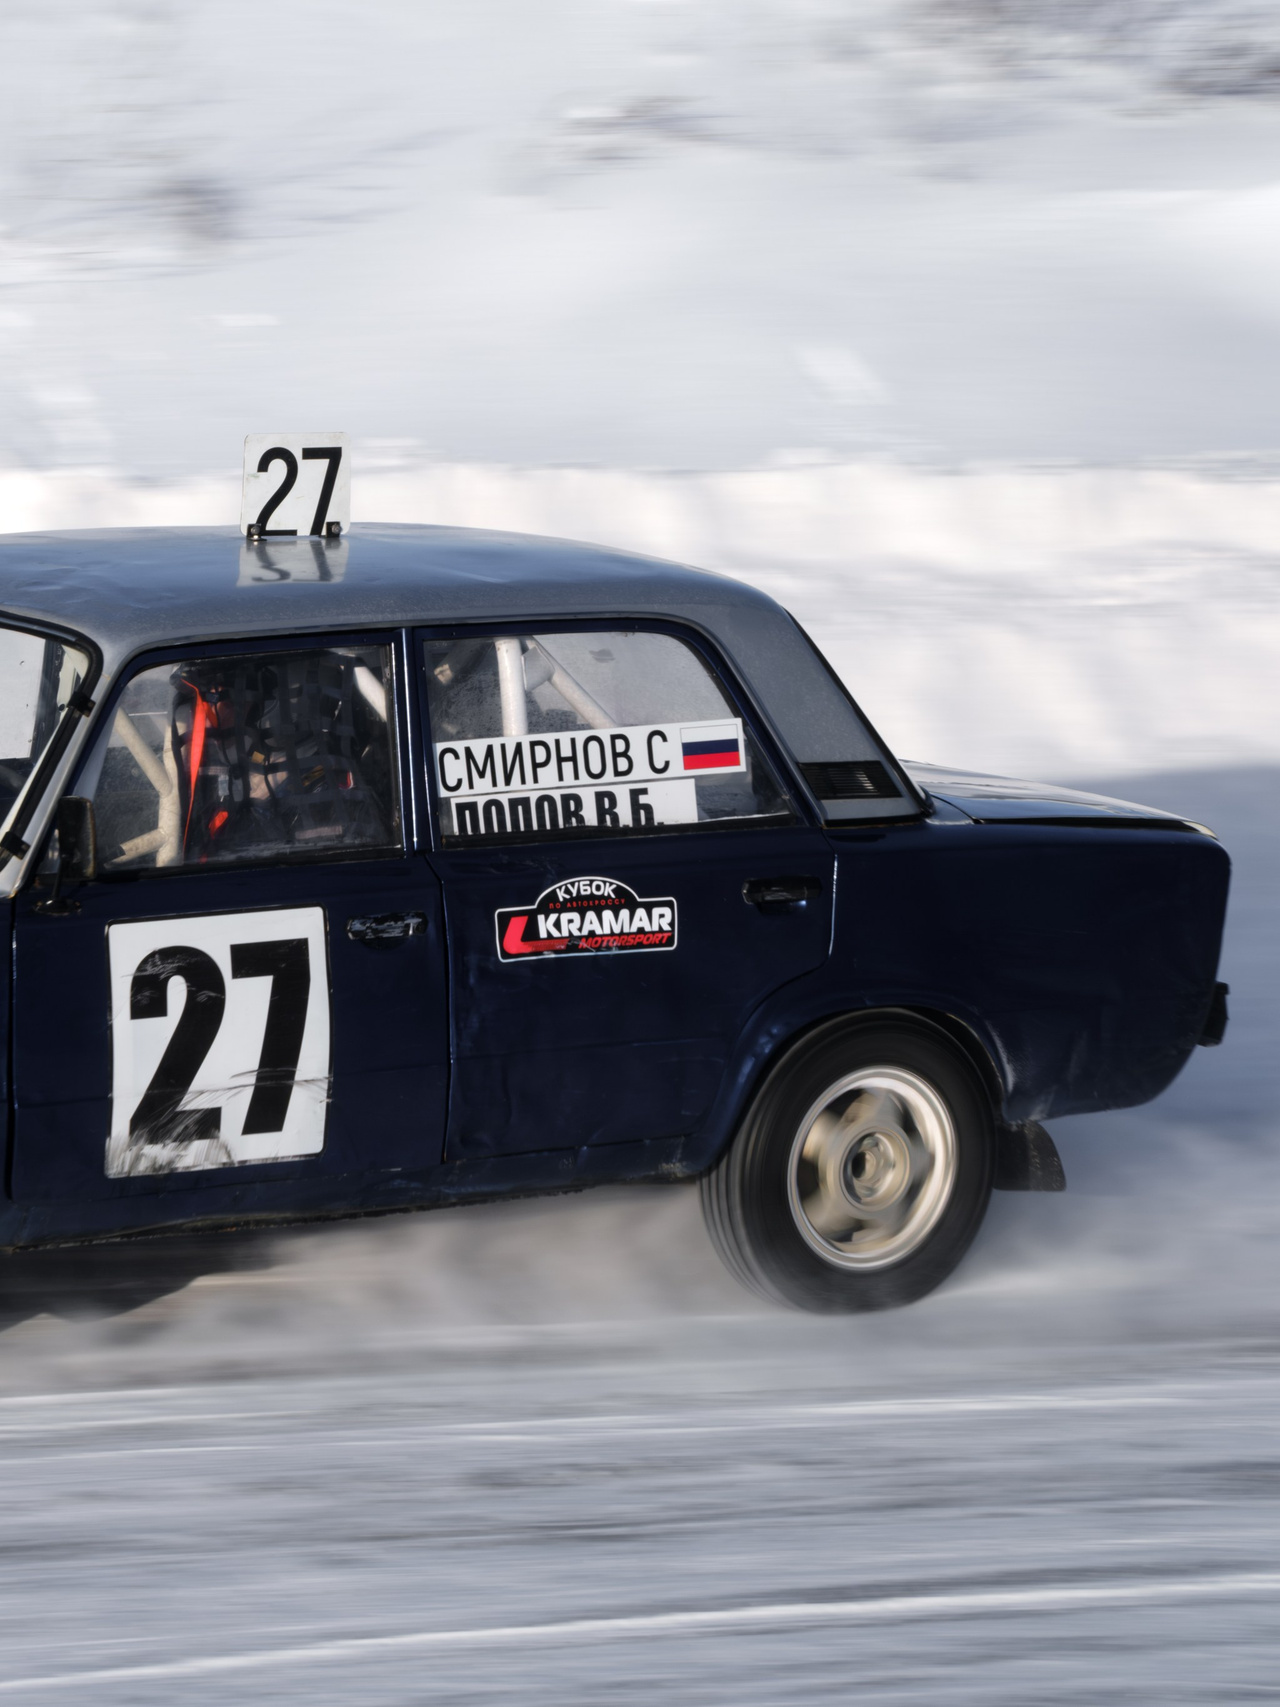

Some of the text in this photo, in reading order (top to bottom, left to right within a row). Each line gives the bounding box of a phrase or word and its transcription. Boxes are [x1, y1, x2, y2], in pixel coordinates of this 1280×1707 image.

[254, 446, 343, 536] 27
[438, 729, 671, 793] СМИРНОВ С
[454, 792, 587, 836] ПОПОВ
[555, 880, 618, 902] КУБОК
[537, 906, 673, 939] KRAMAR
[577, 931, 673, 950] MOTORSPORT
[128, 937, 312, 1146] 27
